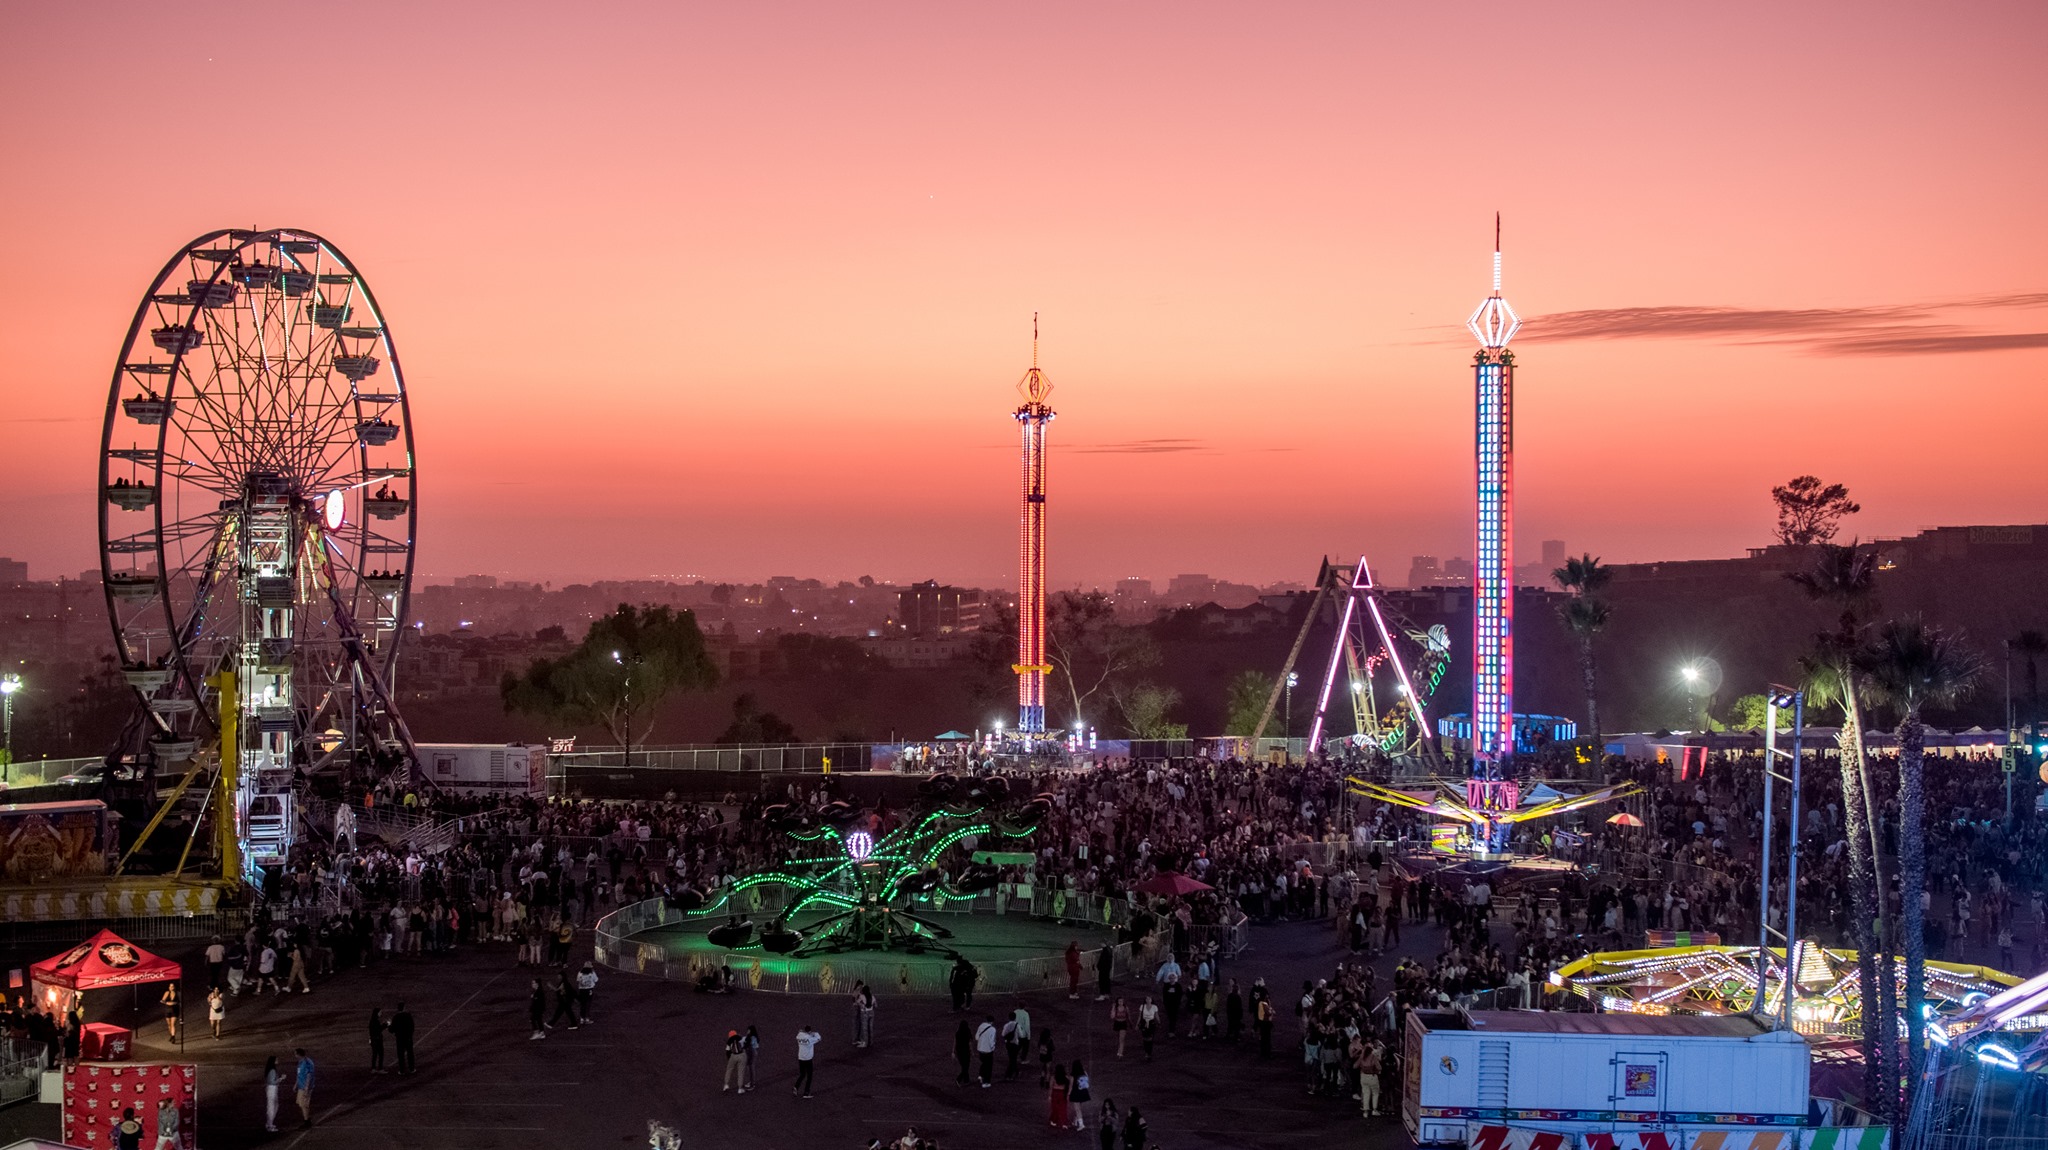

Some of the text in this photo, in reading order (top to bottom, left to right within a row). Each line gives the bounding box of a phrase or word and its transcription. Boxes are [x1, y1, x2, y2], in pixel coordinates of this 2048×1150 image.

[553, 744, 573, 752] EXIT
[2006, 748, 2012, 758] 5
[2005, 761, 2012, 770] 5
